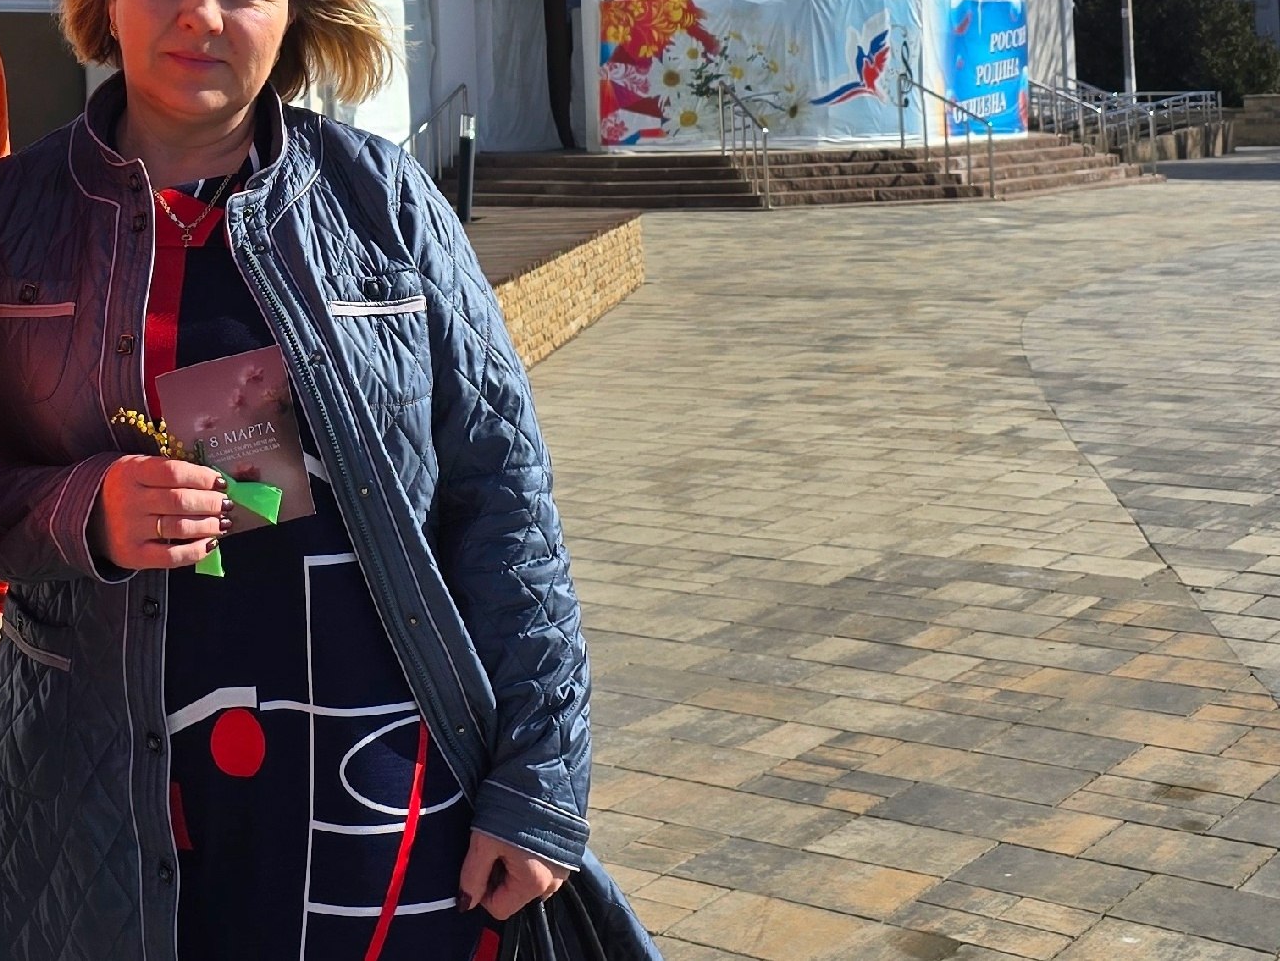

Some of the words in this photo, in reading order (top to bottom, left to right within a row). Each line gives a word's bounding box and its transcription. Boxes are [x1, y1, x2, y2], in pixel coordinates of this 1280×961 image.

[989, 25, 1026, 53] РОССИ
[975, 57, 1020, 86] РОДИНА
[952, 91, 1007, 124] ОТЧИЗНА
[209, 436, 219, 448] 8
[223, 421, 276, 443] МАРТА
